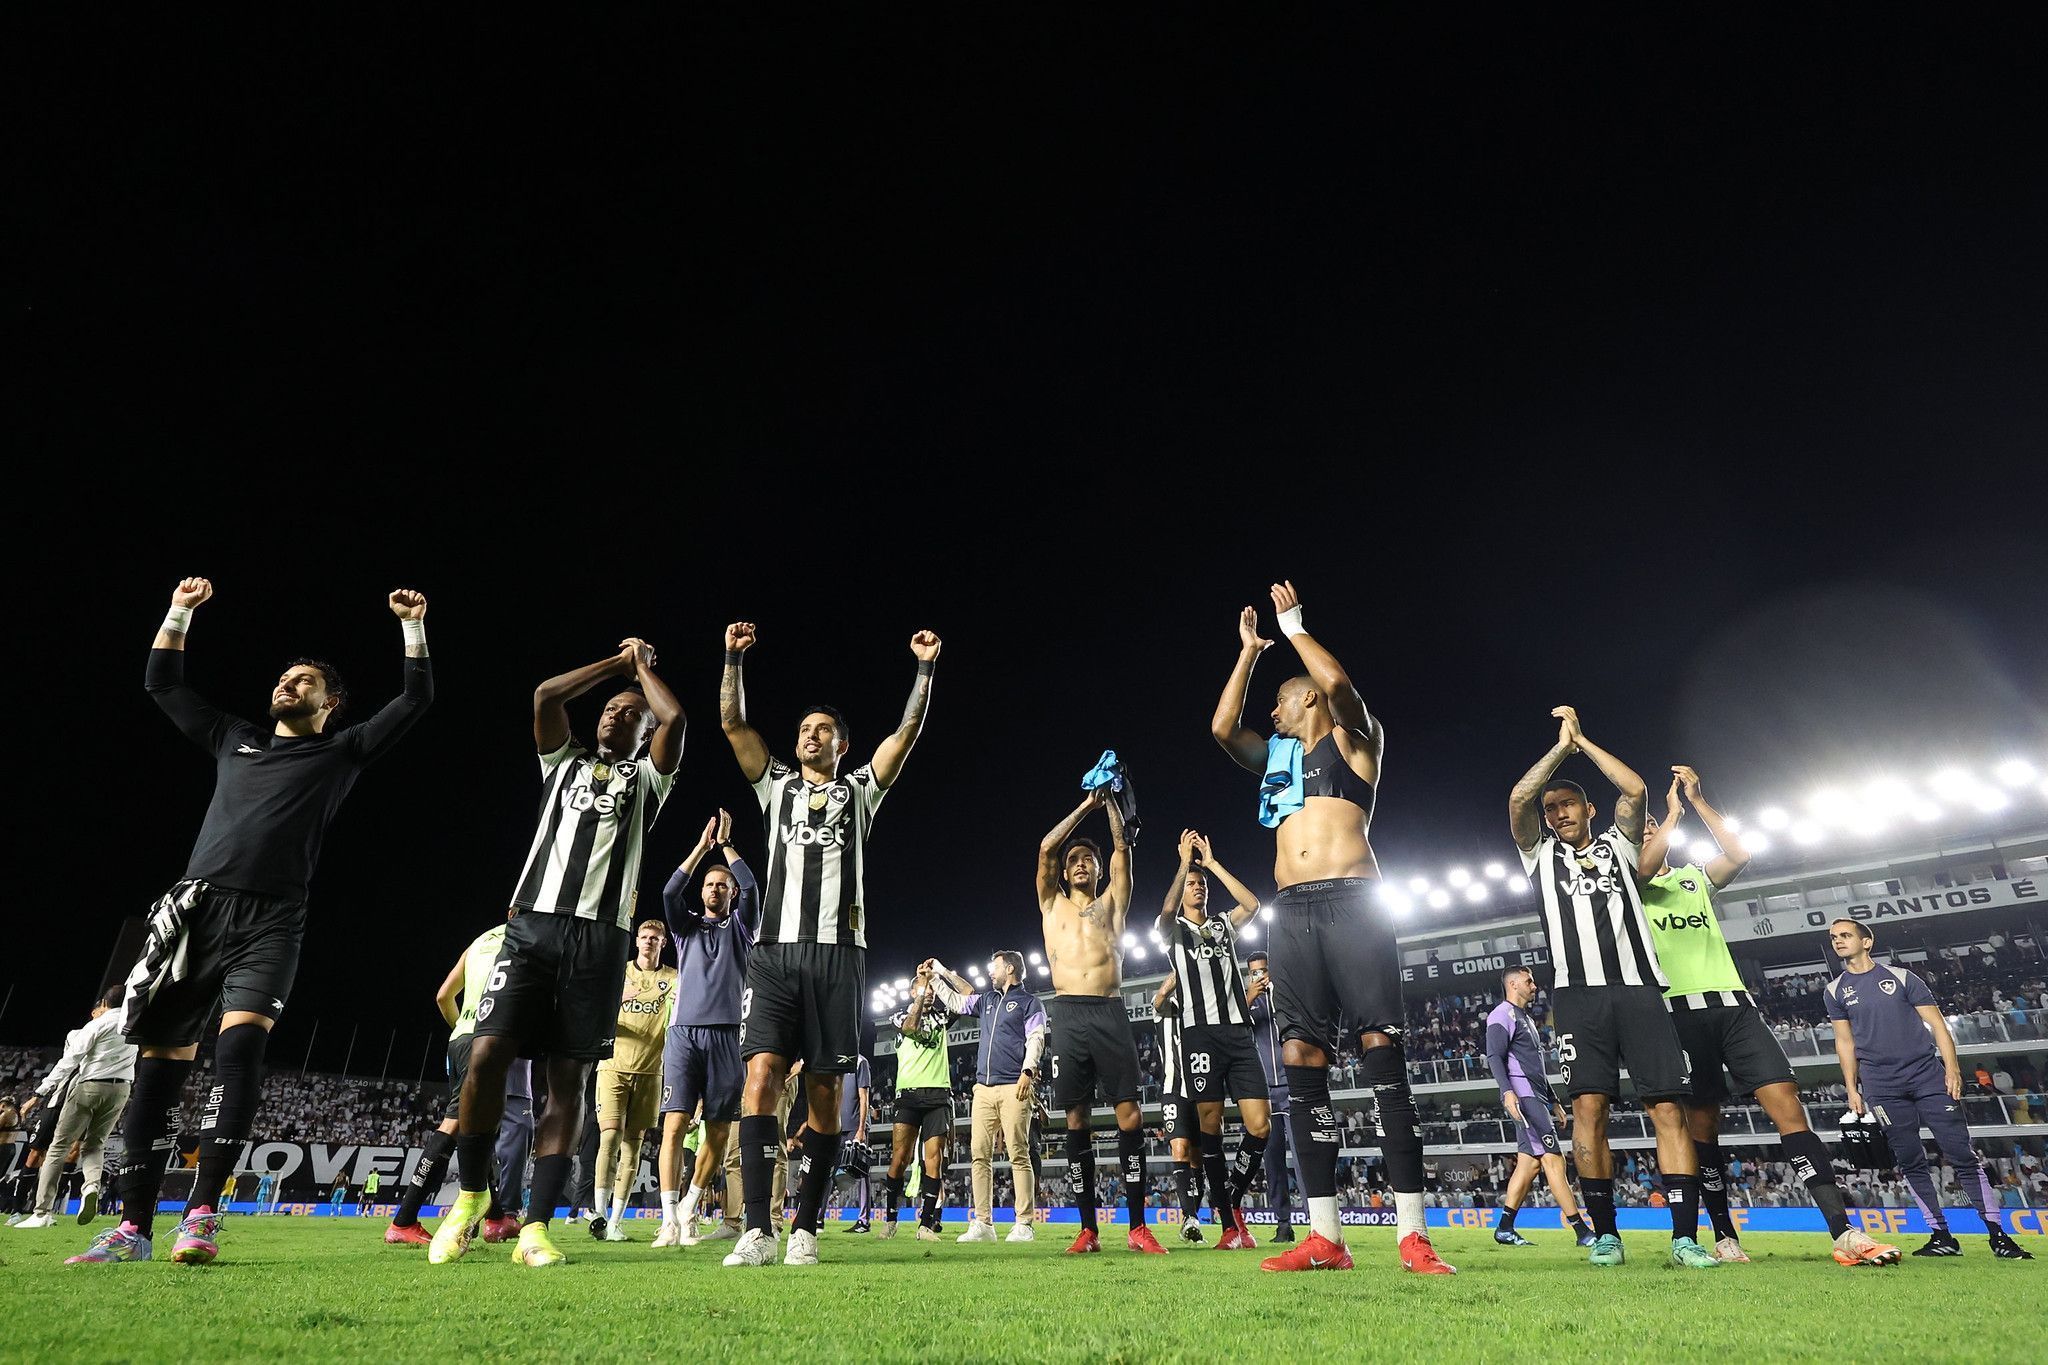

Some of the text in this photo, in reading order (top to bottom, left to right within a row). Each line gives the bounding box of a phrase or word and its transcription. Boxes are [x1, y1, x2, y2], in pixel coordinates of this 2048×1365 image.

[561, 786, 626, 818] vbet
[780, 821, 845, 846] vbet
[1296, 881, 1334, 893] Kappa
[1560, 873, 1622, 896] vbet
[1806, 878, 2039, 927] O SANTOS É
[1653, 912, 1710, 931] vbet
[1188, 943, 1231, 960] vbet
[1452, 956, 1506, 976] COMO
[1520, 949, 1549, 967] EL
[621, 999, 660, 1014] vbet
[949, 1029, 982, 1044] VIVE
[1190, 1052, 1211, 1074] 28
[1163, 1103, 1178, 1121] 39
[1448, 1209, 1494, 1228] CBF
